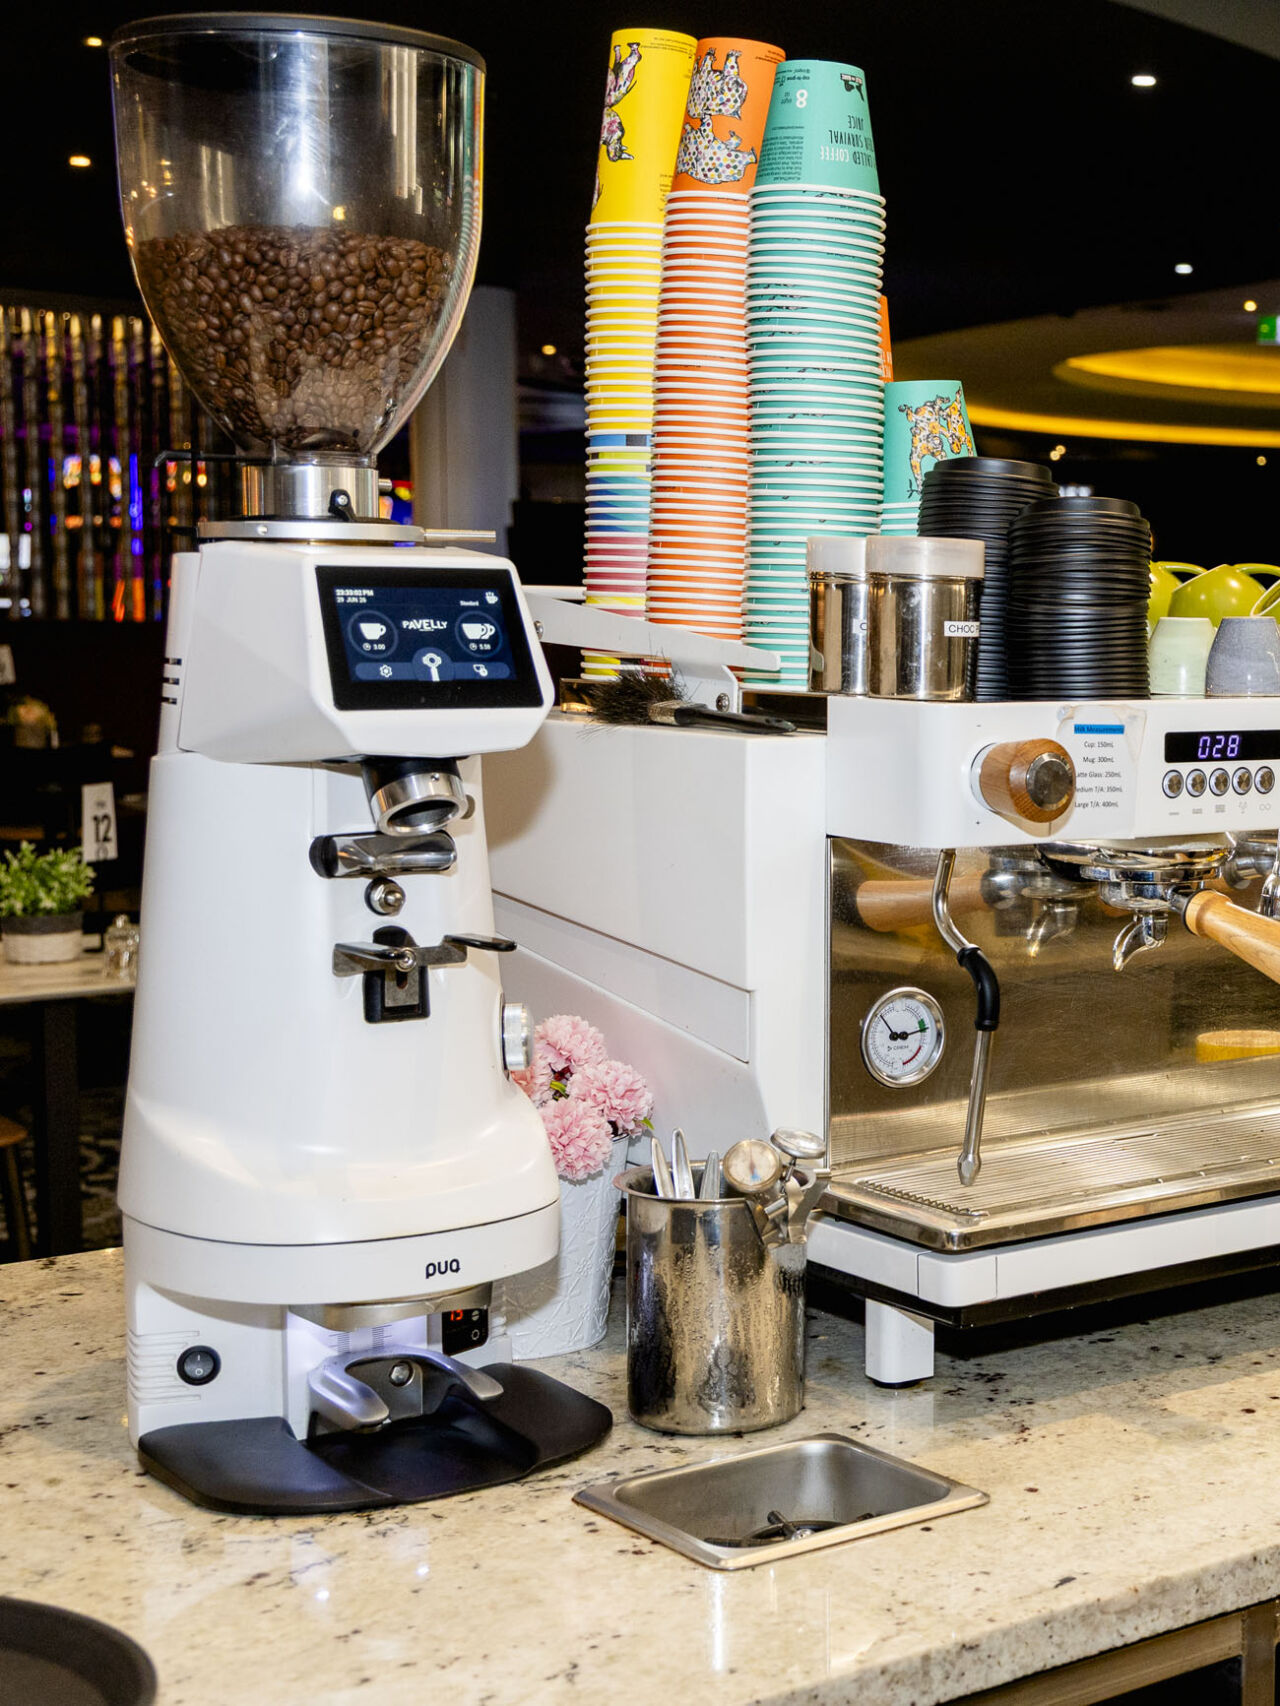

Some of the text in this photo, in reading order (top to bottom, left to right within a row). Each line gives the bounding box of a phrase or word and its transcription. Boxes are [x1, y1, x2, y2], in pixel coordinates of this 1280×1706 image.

[796, 89, 808, 108] 8
[848, 115, 864, 131] JUICE
[828, 130, 864, 148] SURVIVAL
[820, 145, 850, 162] COFFEE
[402, 619, 448, 630] PAVELLY
[948, 624, 975, 634] CHOC
[1084, 741, 1096, 749] Cup:
[1198, 735, 1240, 758] 028
[93, 814, 112, 842] 12
